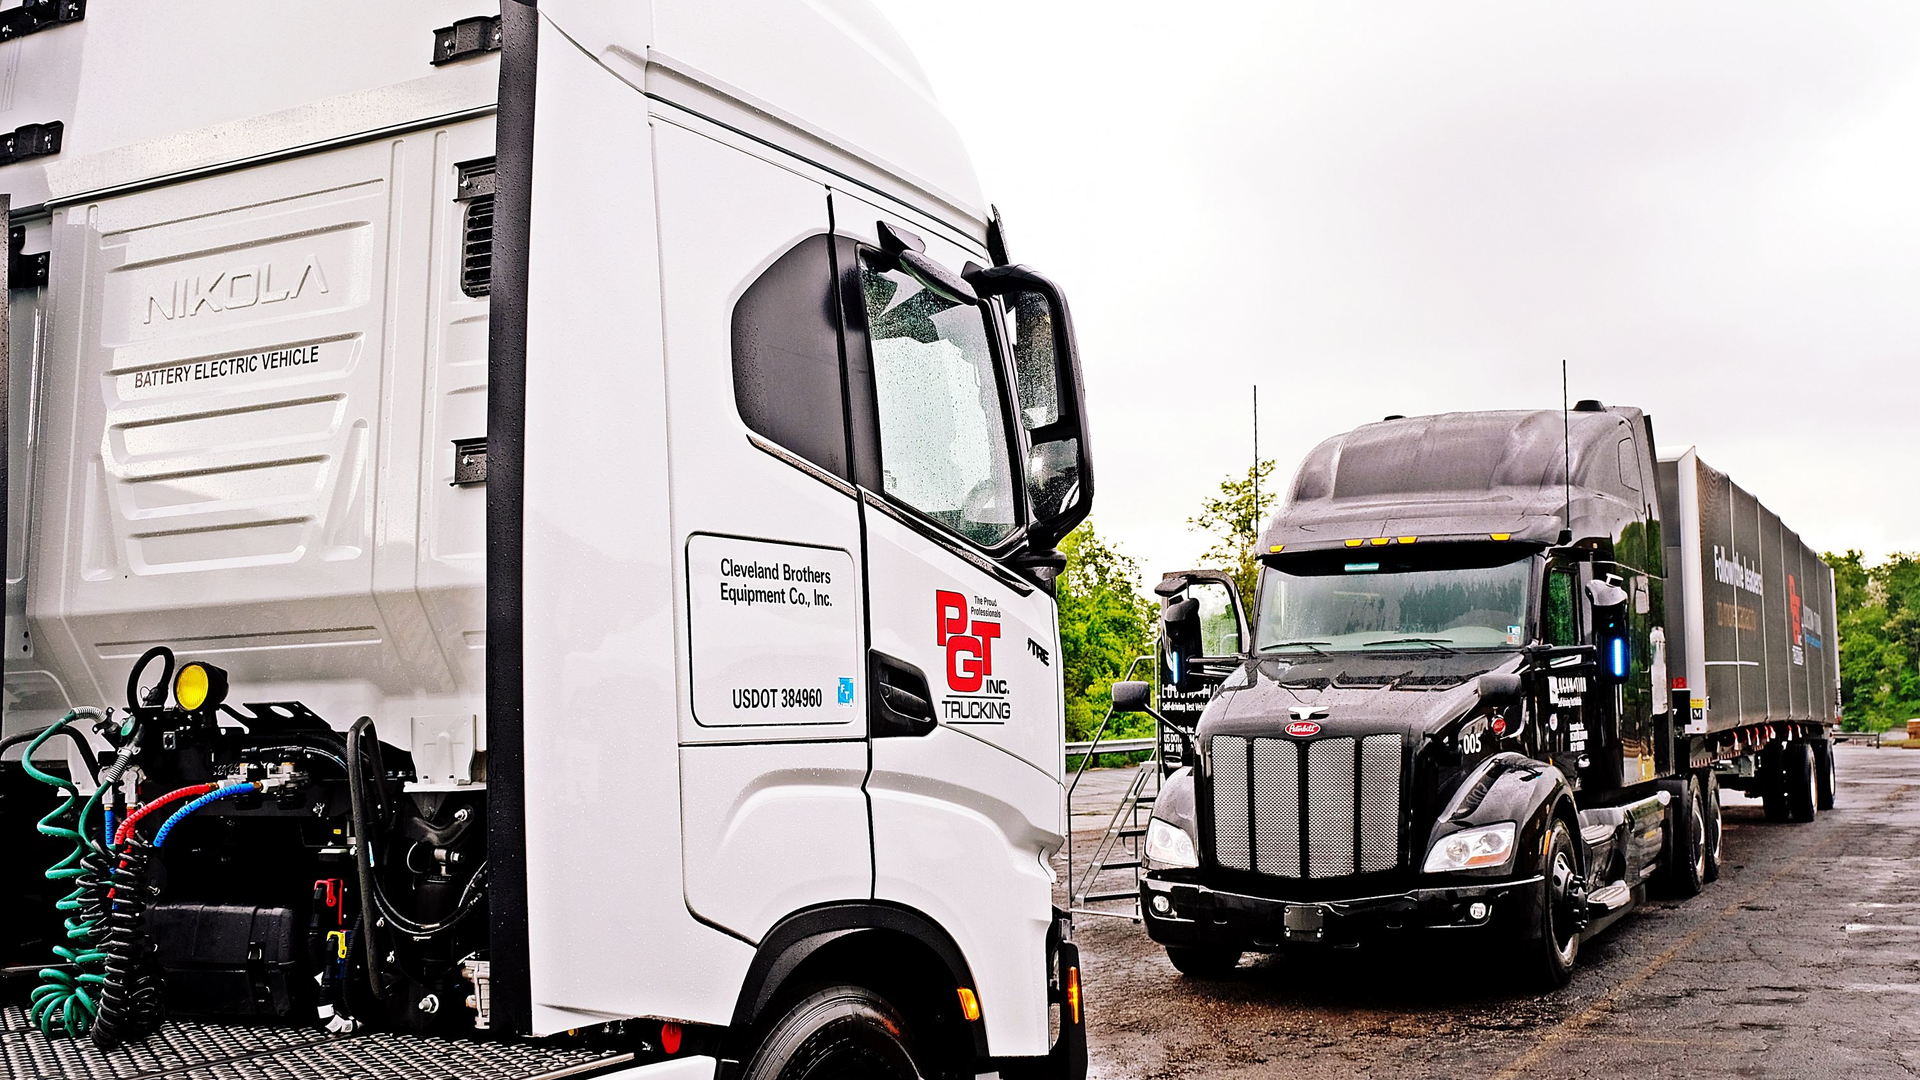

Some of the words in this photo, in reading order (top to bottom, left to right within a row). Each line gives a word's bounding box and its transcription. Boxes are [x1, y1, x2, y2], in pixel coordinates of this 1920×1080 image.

[144, 253, 329, 325] NIKOLA
[134, 365, 191, 389] BATTERY
[194, 355, 258, 380] ELECTRIC
[262, 346, 319, 370] VEHICLE
[720, 558, 779, 580] Cleveland
[783, 563, 831, 584] Brothers
[720, 583, 786, 606] Equipment
[789, 587, 811, 608] Co.,
[814, 589, 833, 606] Inc.
[974, 596, 983, 606] The
[983, 598, 997, 607] Proud
[971, 606, 1001, 618] Professionals
[986, 679, 1010, 694] INC.
[732, 688, 778, 708] USDOT
[781, 688, 822, 708] 384960
[942, 700, 1011, 719] TRUCKING
[1463, 733, 1482, 755] 005
